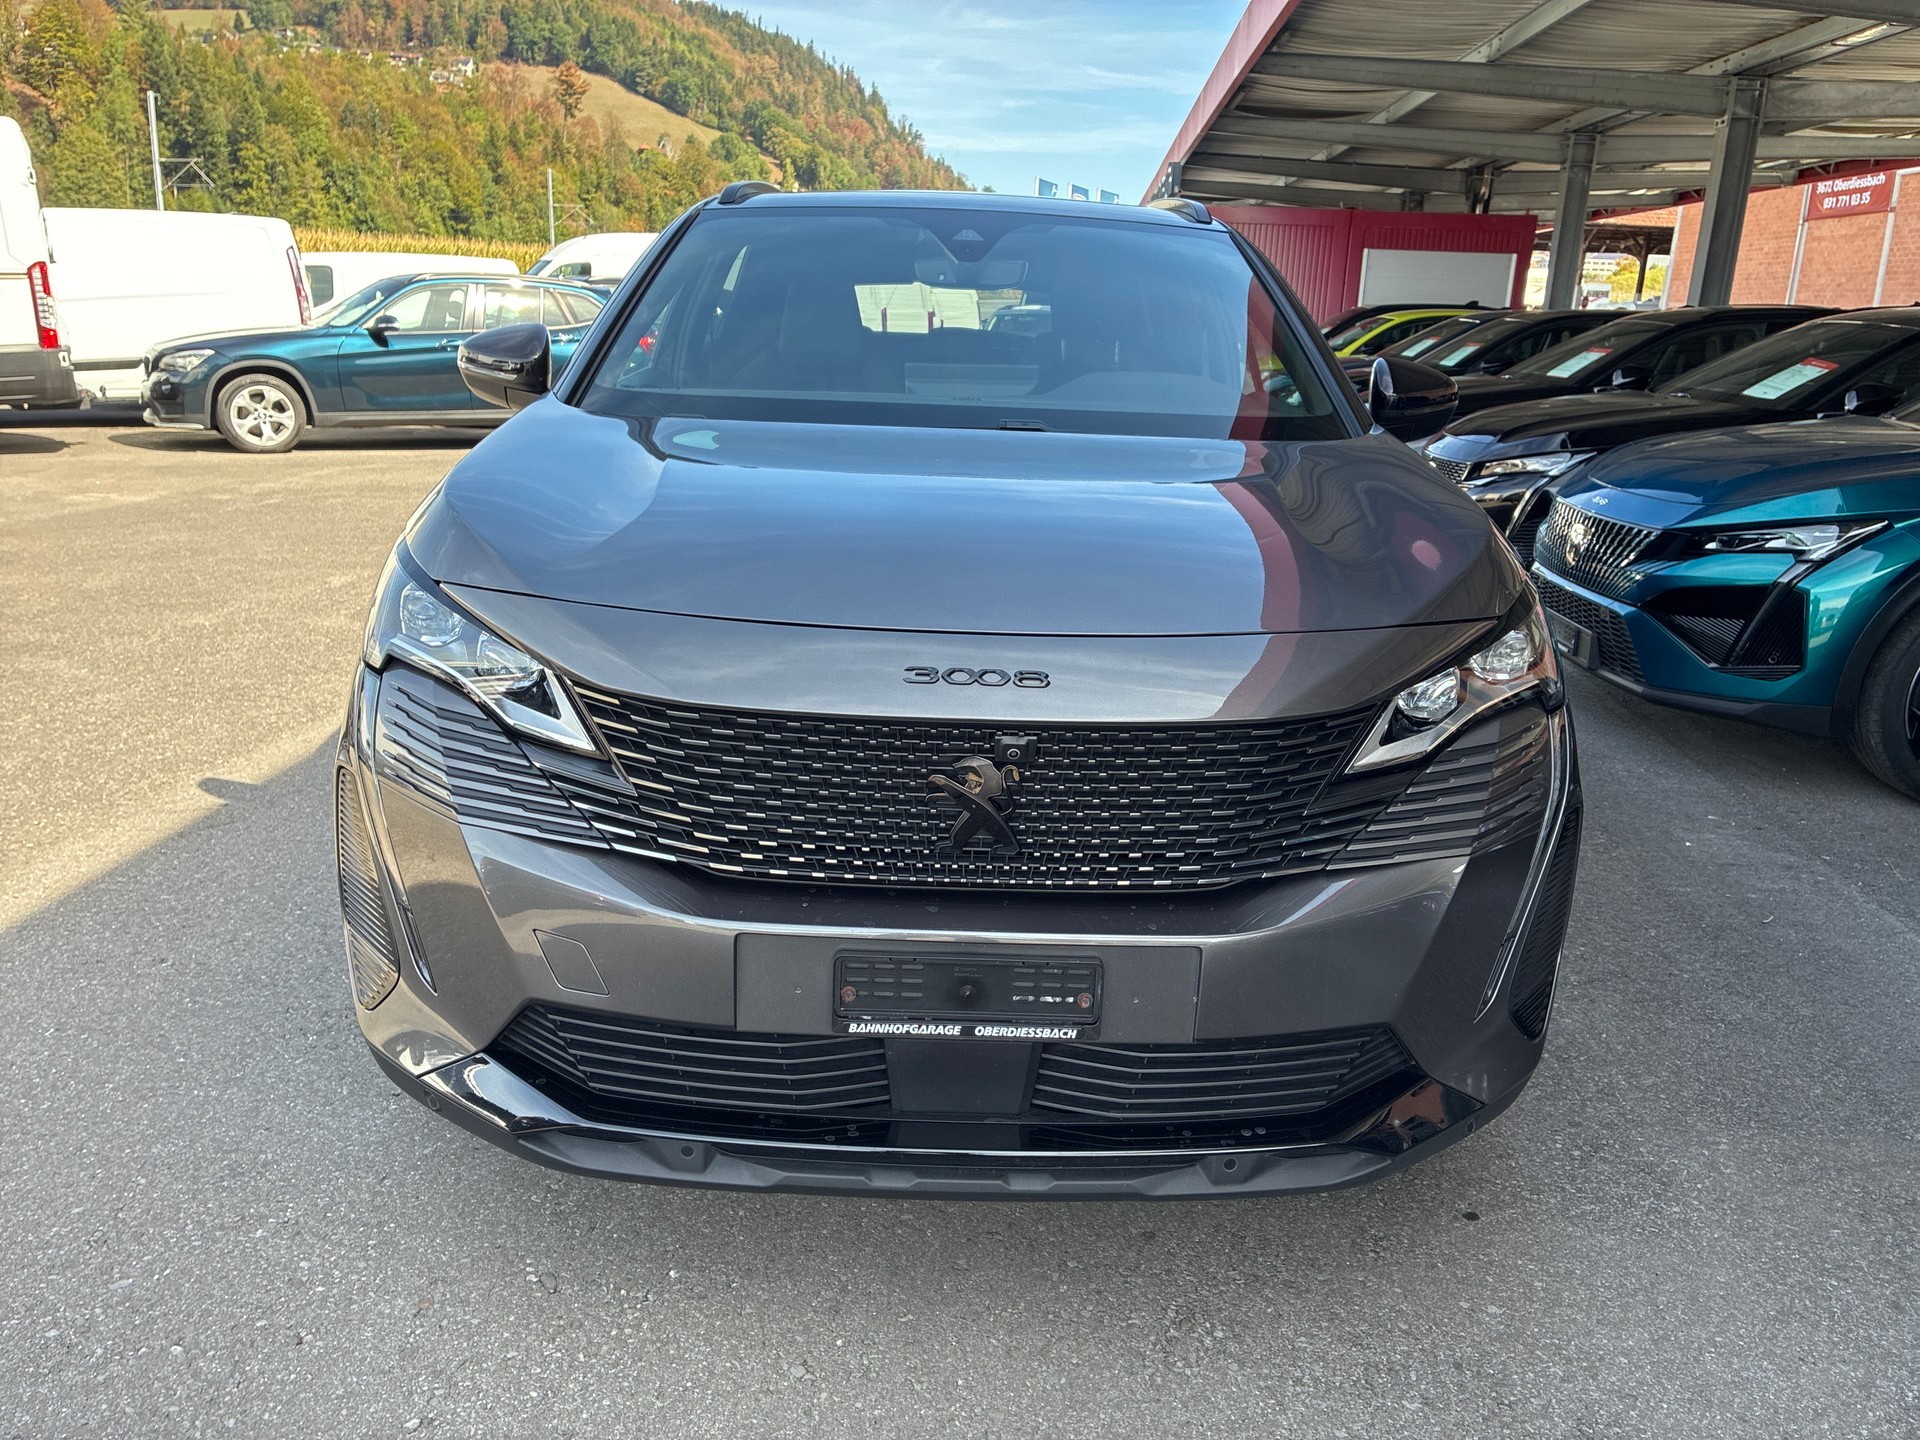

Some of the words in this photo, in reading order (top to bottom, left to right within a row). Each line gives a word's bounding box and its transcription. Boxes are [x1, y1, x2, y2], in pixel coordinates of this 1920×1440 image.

[1816, 182, 1833, 194] 3672
[1833, 172, 1885, 191] Oberdiessbach
[1823, 197, 1836, 209] 031
[1837, 195, 1850, 208] 771
[1850, 193, 1861, 206] 03
[1860, 192, 1871, 204] 55
[902, 665, 1051, 689] 3008
[848, 1023, 962, 1036] BAHNHOFGARAGE
[974, 1026, 1078, 1039] OBERDIESSBACH
